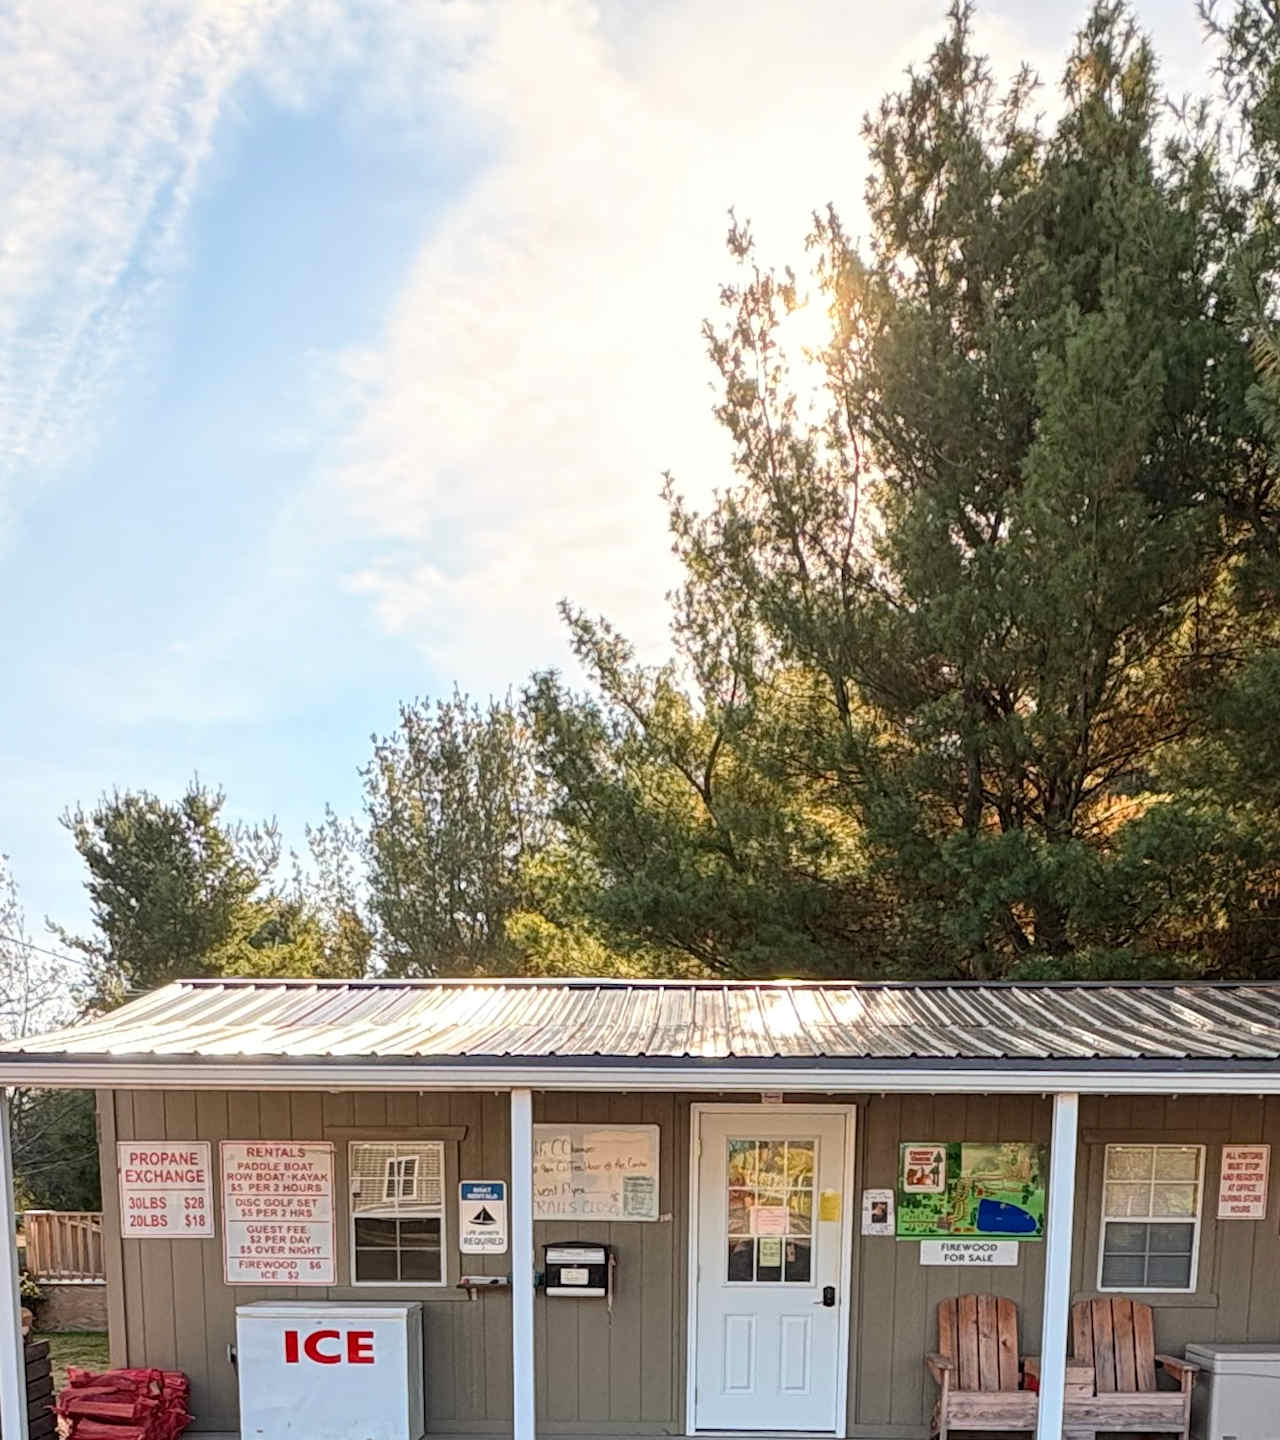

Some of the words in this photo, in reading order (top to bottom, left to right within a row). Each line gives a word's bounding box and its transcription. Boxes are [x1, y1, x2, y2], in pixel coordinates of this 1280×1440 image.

[246, 1147, 306, 1158] RENTALS
[1225, 1152, 1237, 1160] ALL
[129, 1152, 199, 1166] PROPANE
[237, 1162, 280, 1171] PADDLE
[283, 1163, 314, 1171] BOAT
[125, 1169, 205, 1183] EXCHANGE
[227, 1173, 252, 1181] ROW
[249, 1184, 270, 1192] PER
[273, 1184, 280, 1192] 2
[282, 1184, 322, 1192] HOURS
[1227, 1184, 1235, 1192] AT
[1236, 1184, 1256, 1192] OFFICE
[129, 1196, 167, 1209] 30LBS
[184, 1196, 205, 1210] $28
[235, 1199, 260, 1207] DISC
[263, 1199, 294, 1207] GOLF
[297, 1199, 318, 1207] SET
[256, 1209, 278, 1217] PER
[281, 1209, 287, 1217] 2
[290, 1209, 312, 1217] HRS
[1231, 1205, 1250, 1213] HOURS
[130, 1214, 168, 1227] 20LBS
[185, 1214, 205, 1228] $18
[246, 1225, 283, 1234] GUEST
[287, 1226, 307, 1234] FEE
[249, 1235, 262, 1244] $2
[265, 1235, 287, 1244] PER
[290, 1236, 312, 1244] DAY
[464, 1237, 504, 1246] REQUIRED
[255, 1246, 285, 1254] OVER
[941, 1243, 997, 1251] FIREWOOD
[944, 1253, 964, 1262] FOR
[968, 1254, 993, 1262] SALE
[239, 1261, 297, 1270] FIREWOOD
[260, 1271, 278, 1279] ICE
[285, 1329, 375, 1364] ICE
